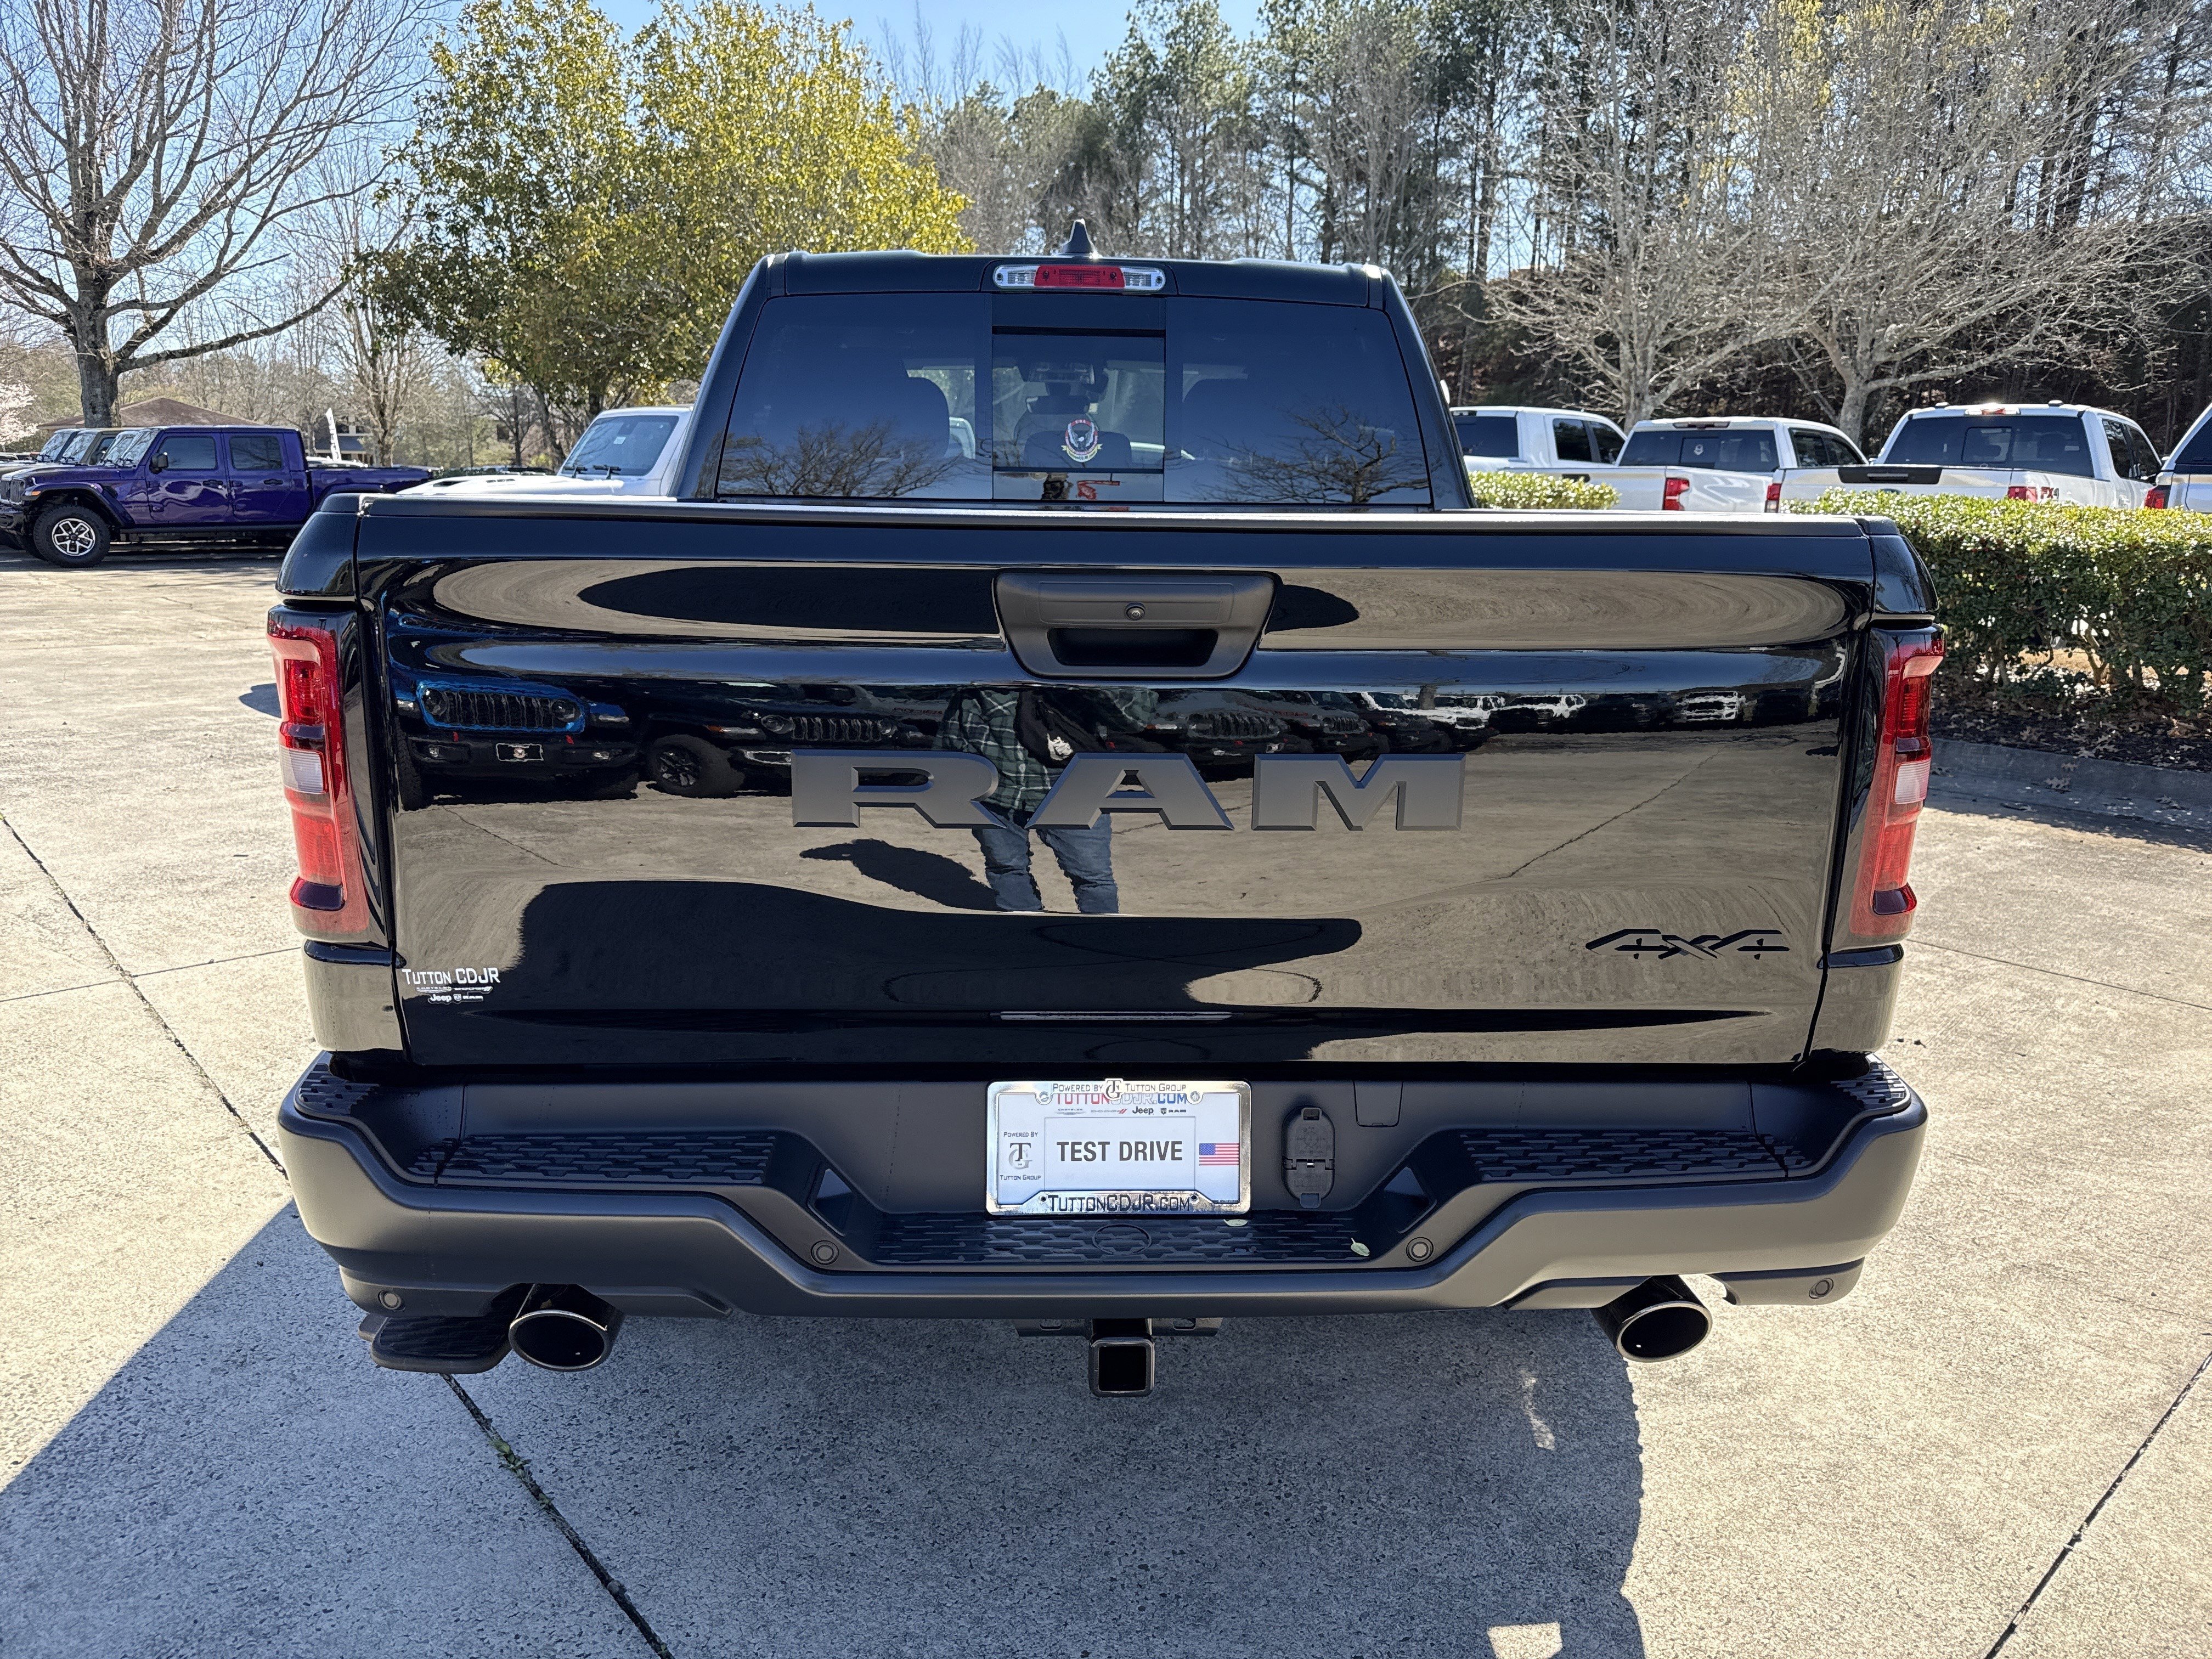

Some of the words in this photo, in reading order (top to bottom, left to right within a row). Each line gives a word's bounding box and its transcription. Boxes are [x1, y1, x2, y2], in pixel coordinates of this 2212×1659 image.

[2040, 486, 2059, 501] FX4
[790, 749, 1465, 832] RAM
[402, 968, 452, 985] TUTTON
[455, 967, 501, 984] CDJR
[430, 994, 452, 1002] Jeep
[1053, 1083, 1091, 1092] POWERED
[1125, 1083, 1156, 1092] TUTTON
[1159, 1083, 1186, 1092] GROUP
[1132, 1106, 1154, 1115] Jeep
[1057, 1141, 1110, 1161] TEST
[1119, 1141, 1182, 1161] DRIVE
